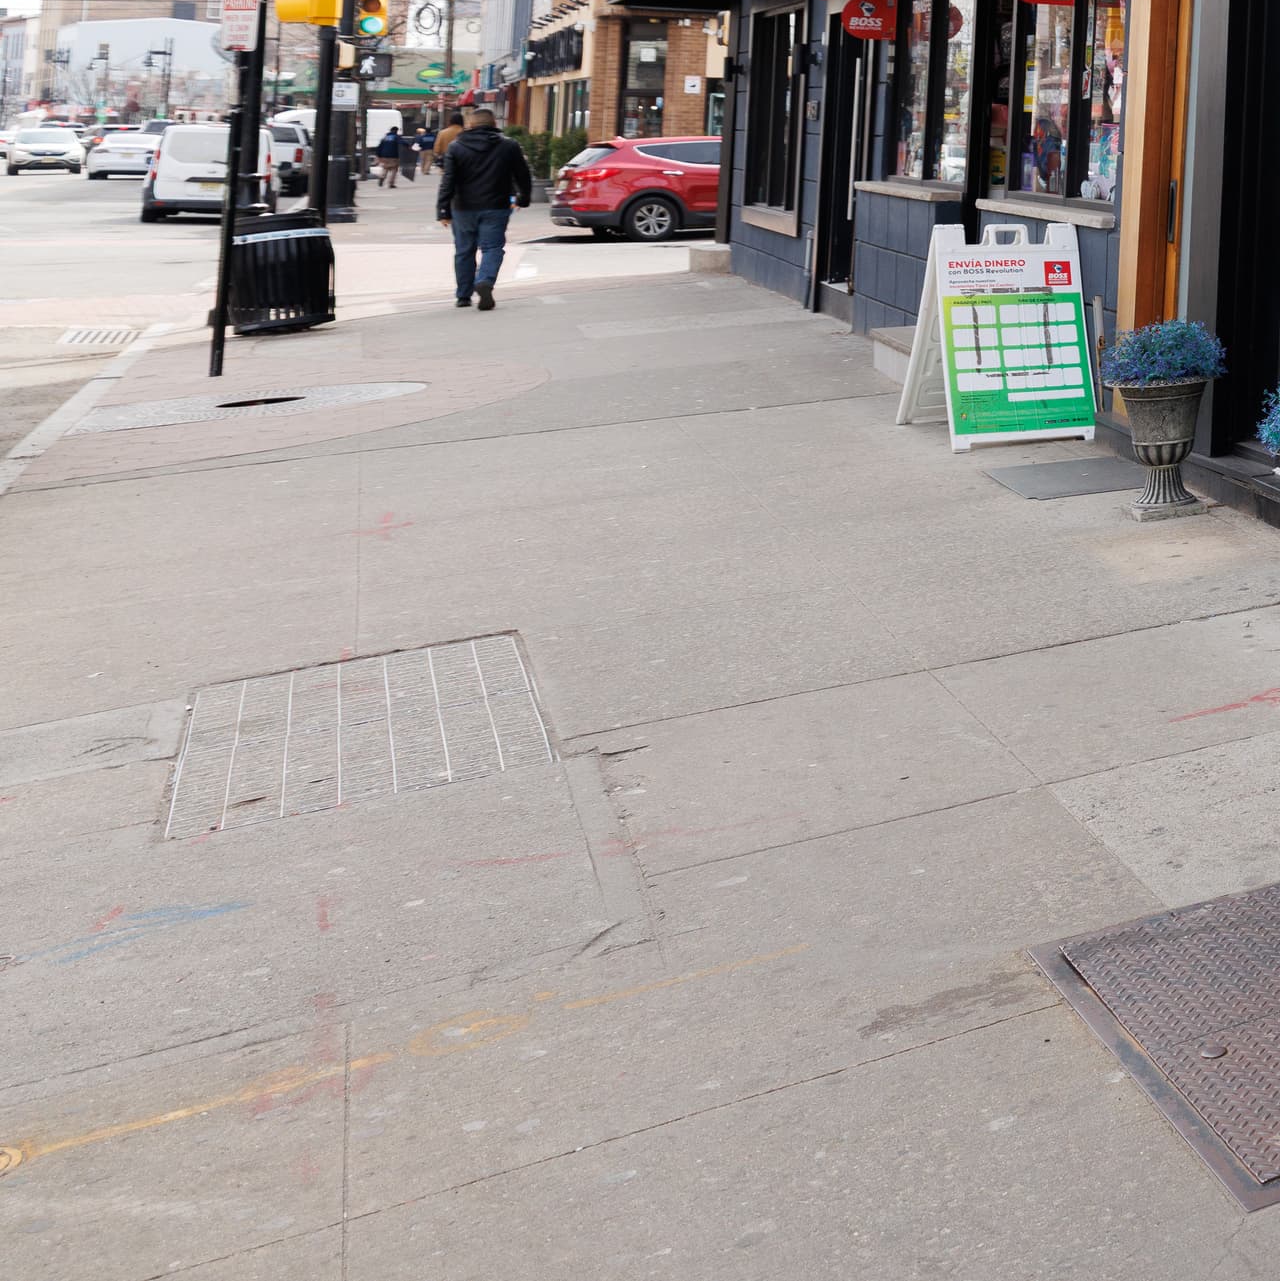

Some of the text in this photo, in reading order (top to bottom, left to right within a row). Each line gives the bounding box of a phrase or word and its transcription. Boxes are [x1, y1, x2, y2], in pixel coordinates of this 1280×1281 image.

[850, 16, 883, 26] BOSS
[948, 259, 1026, 269] ENVÍA DINERO
[985, 267, 1025, 275] Revolution
